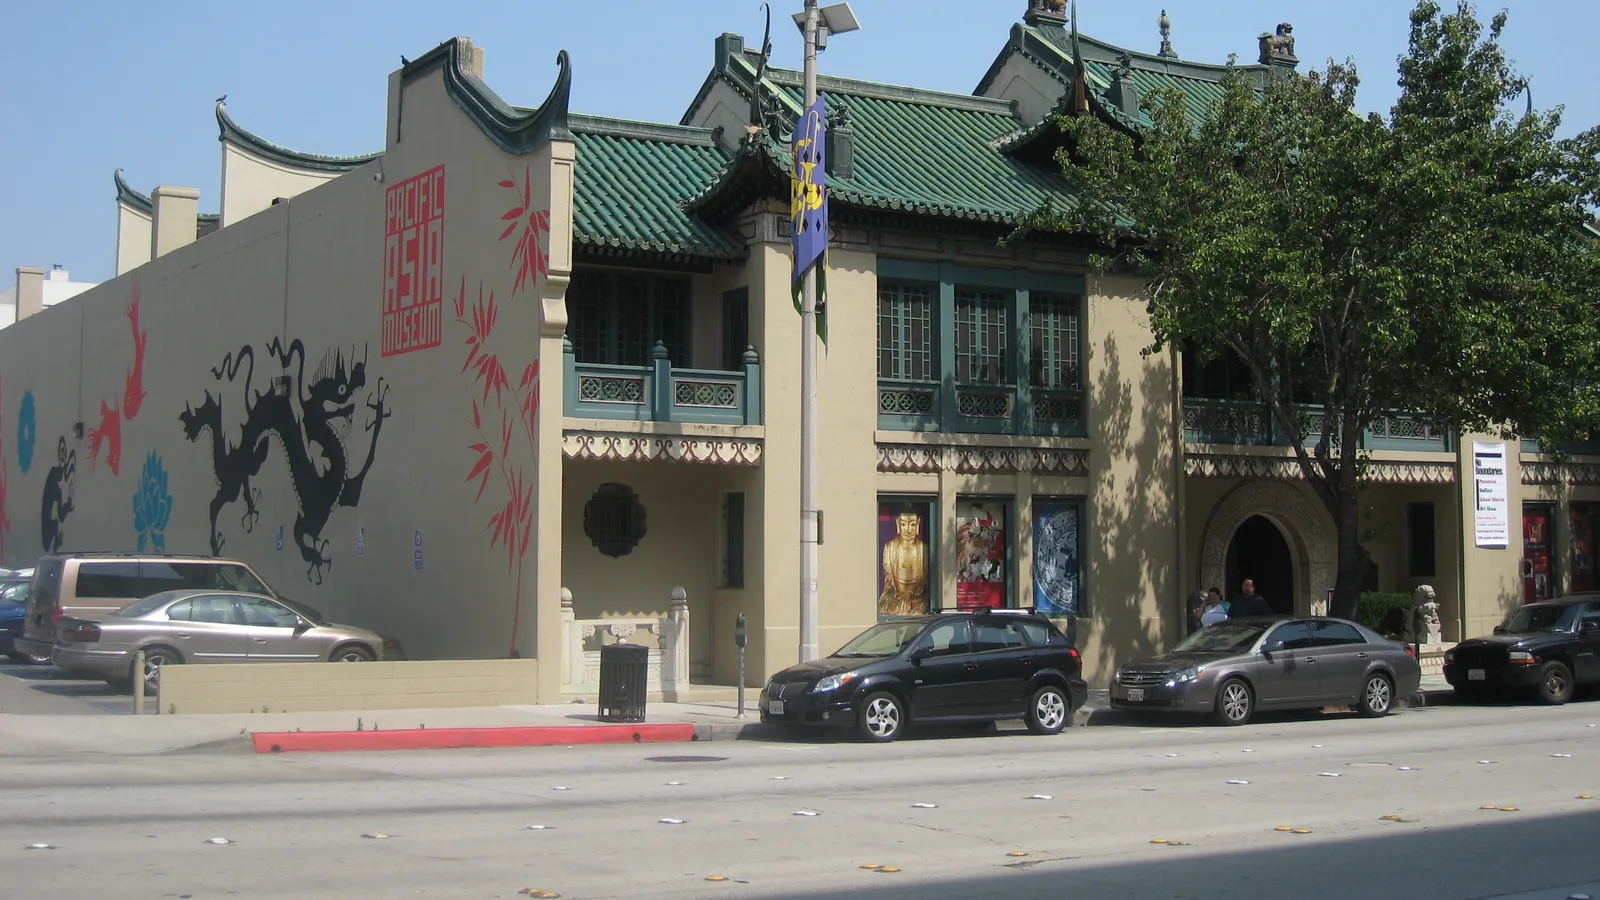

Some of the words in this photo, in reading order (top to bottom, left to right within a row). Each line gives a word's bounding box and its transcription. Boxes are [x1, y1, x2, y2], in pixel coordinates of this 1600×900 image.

[387, 170, 443, 233] PACIFIC
[384, 218, 442, 313] ASIA
[383, 302, 440, 352] MUSEUM
[1475, 467, 1503, 475] Boundaries
